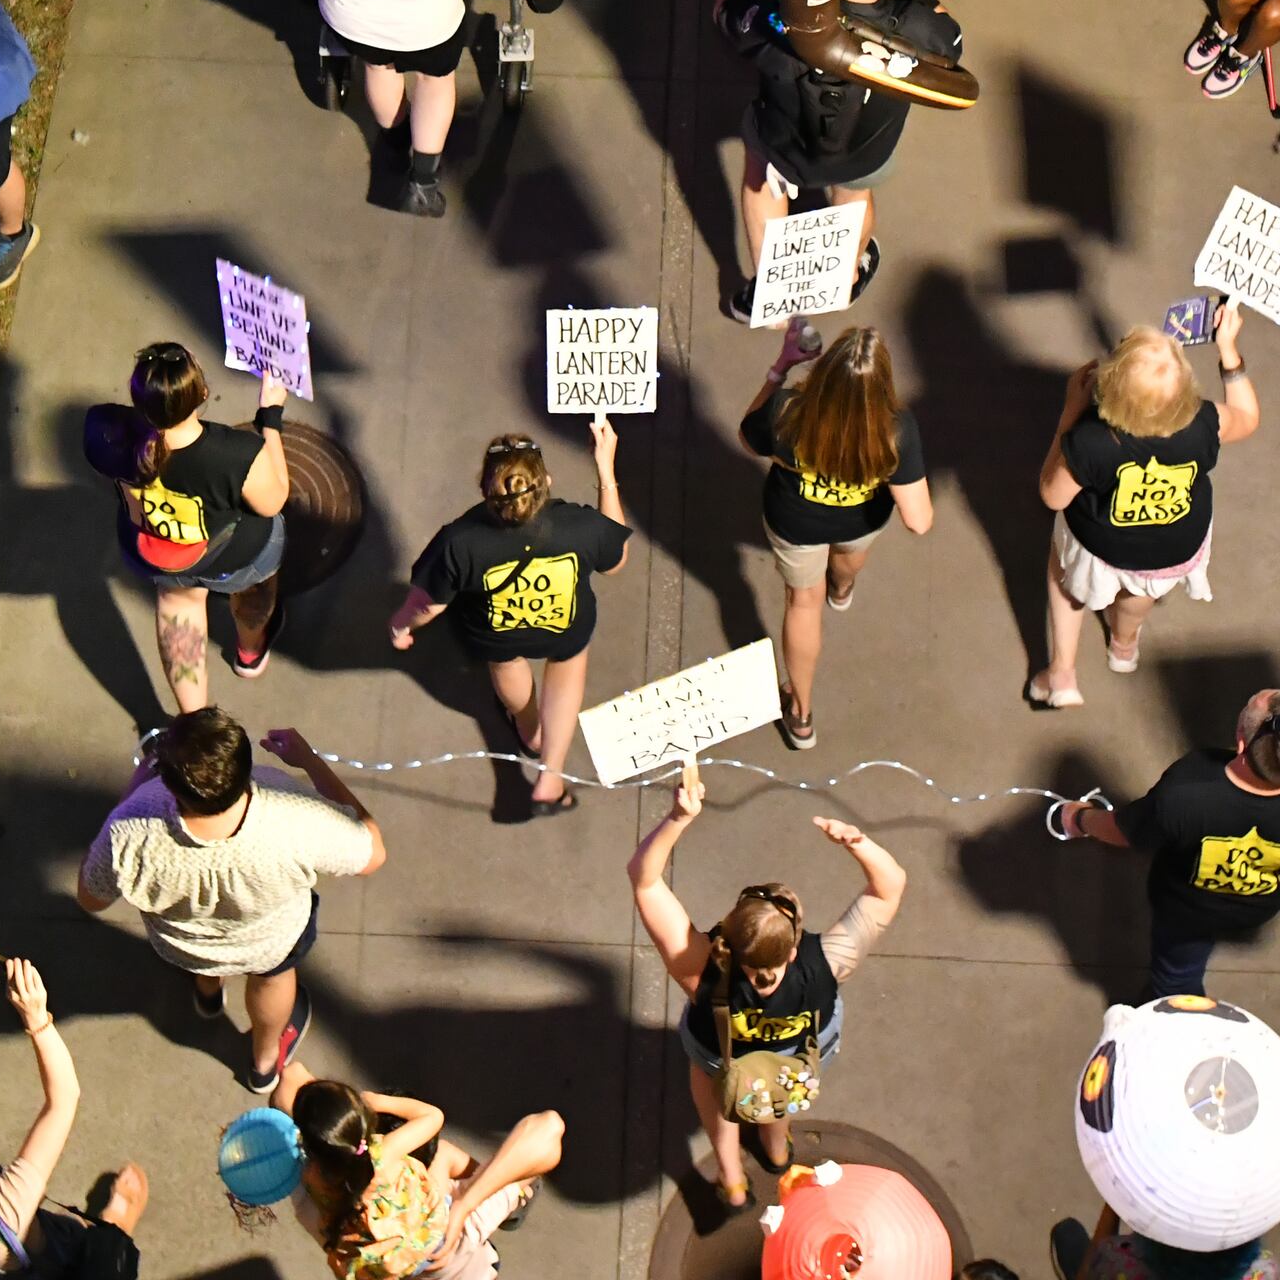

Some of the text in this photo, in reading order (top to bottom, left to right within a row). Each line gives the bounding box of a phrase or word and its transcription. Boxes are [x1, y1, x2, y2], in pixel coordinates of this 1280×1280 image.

[783, 212, 840, 235] PLEASE
[822, 228, 850, 248] UP
[233, 275, 282, 304] PLEASE
[784, 279, 817, 293] THE
[762, 286, 840, 319] BANDS!
[230, 312, 295, 355] BEHIND
[271, 311, 297, 334] UP
[559, 316, 644, 343] HAPPY
[234, 345, 302, 390] BANDS!
[556, 350, 648, 376] LANTERN
[557, 381, 651, 406] PARADE!
[514, 573, 551, 593] DO
[507, 593, 562, 612] NOT
[501, 607, 564, 628] PASS
[1226, 846, 1264, 864] DO
